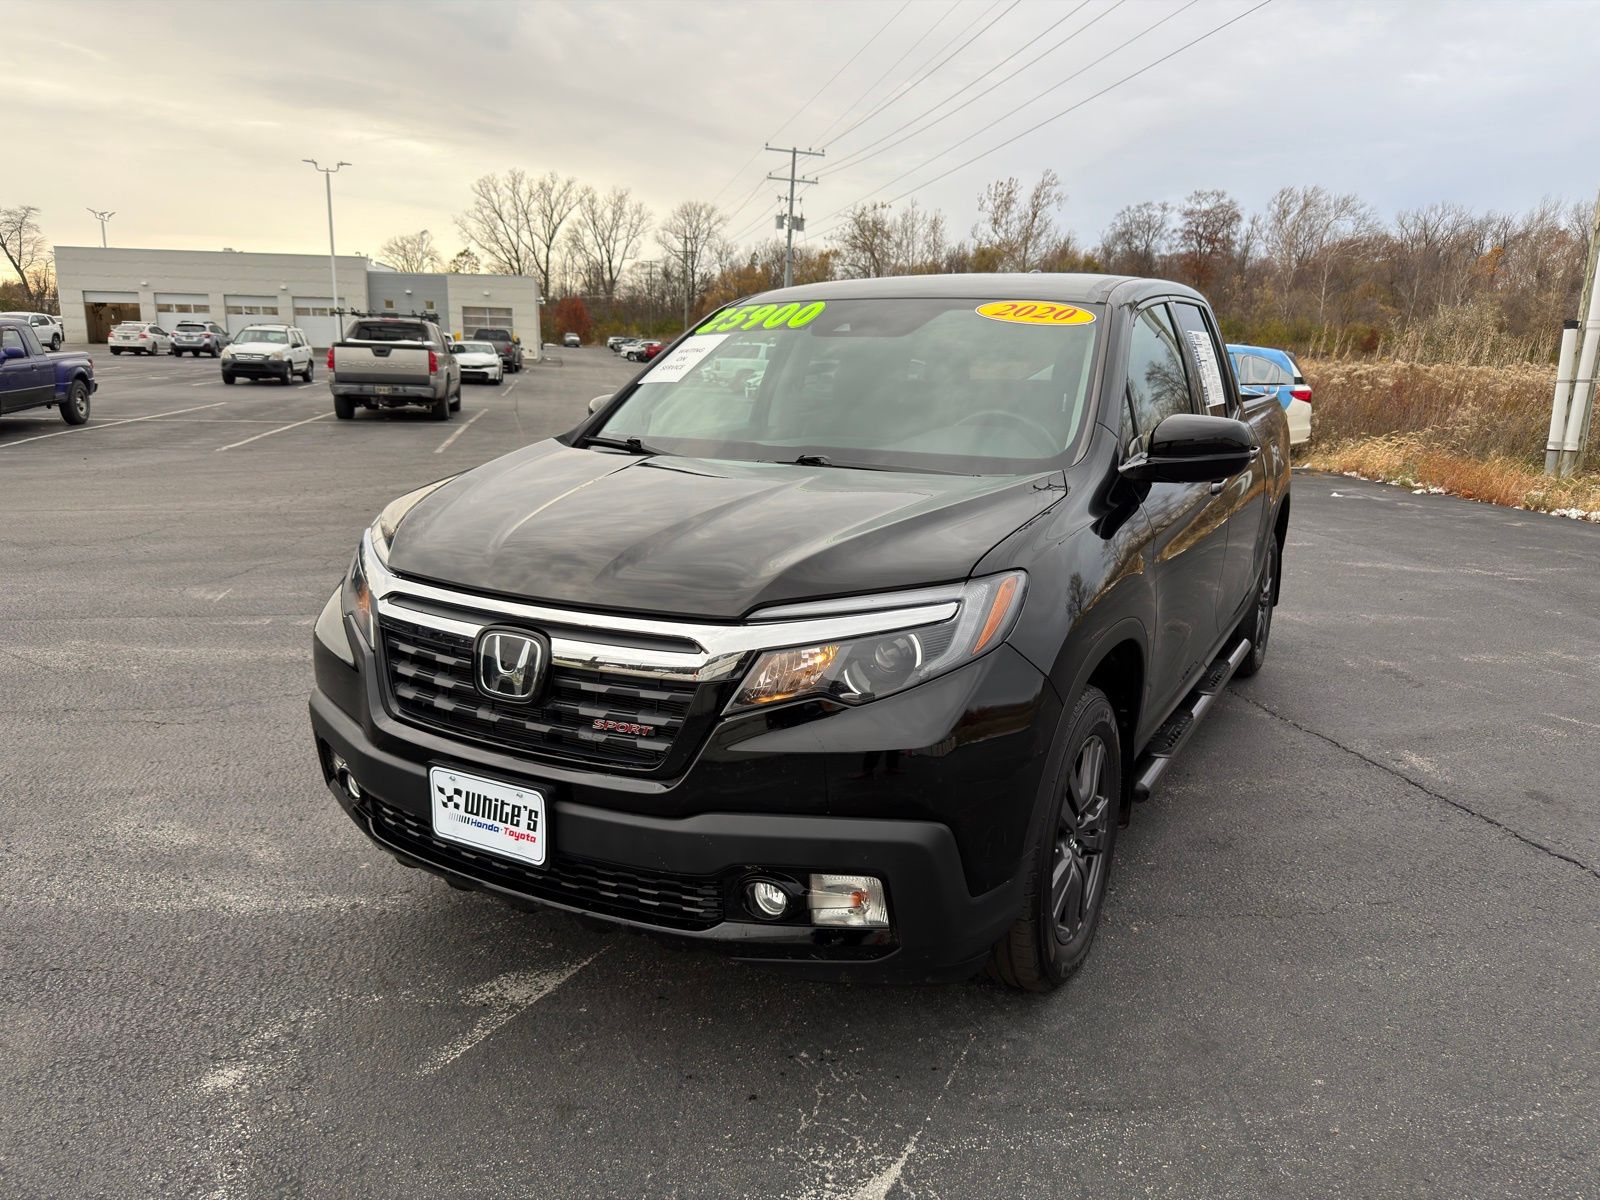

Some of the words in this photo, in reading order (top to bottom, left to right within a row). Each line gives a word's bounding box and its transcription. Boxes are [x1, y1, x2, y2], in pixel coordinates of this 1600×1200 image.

[695, 301, 826, 335] 25900
[992, 304, 1077, 320] 2020
[592, 719, 654, 736] SPORT
[464, 791, 539, 832] White's
[471, 818, 500, 833] Honda
[503, 827, 536, 843] Toyota
